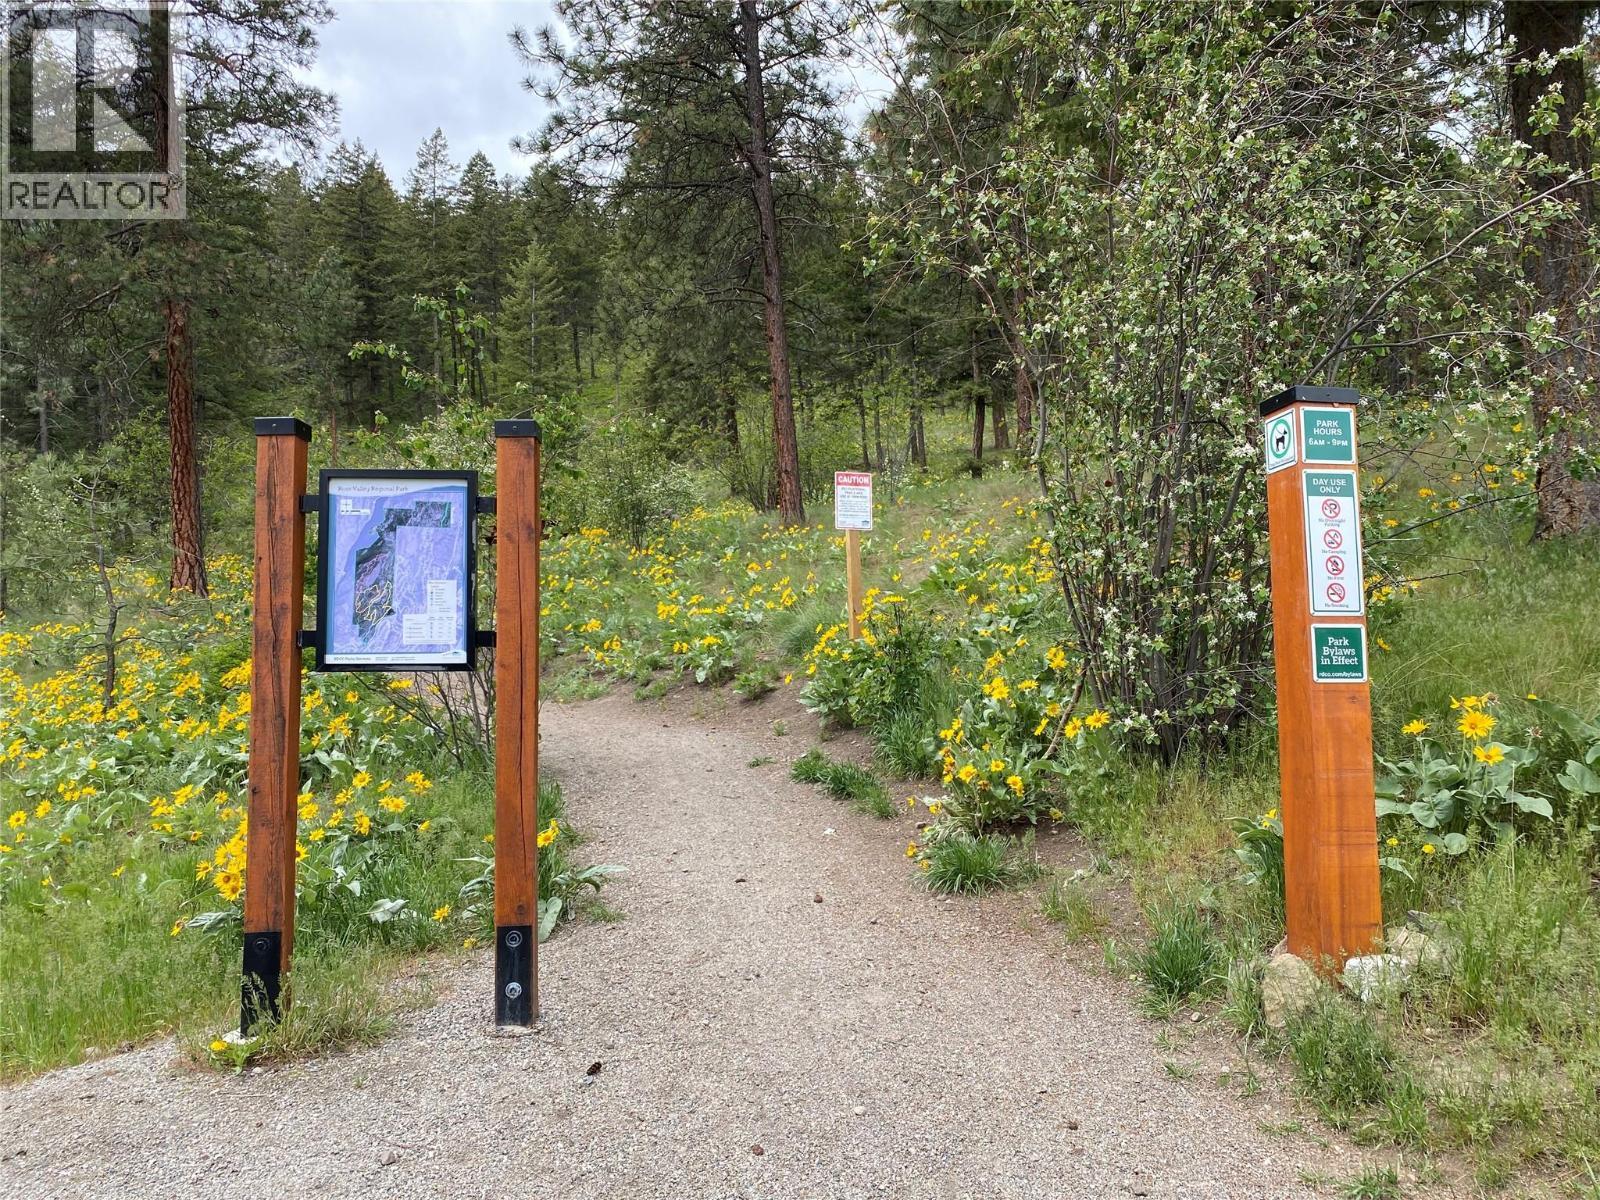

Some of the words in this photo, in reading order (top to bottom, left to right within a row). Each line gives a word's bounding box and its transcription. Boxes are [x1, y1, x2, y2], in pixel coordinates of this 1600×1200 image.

[1316, 420, 1339, 428] PARK
[1313, 428, 1343, 436] HOURS
[1308, 437, 1325, 446] 6AM
[1331, 438, 1348, 447] 9PM
[838, 475, 869, 484] CAUTION
[1313, 478, 1329, 486] DAY
[1330, 478, 1347, 486] USE
[1320, 486, 1341, 494] ONLY
[1328, 637, 1349, 646] Park
[1322, 646, 1356, 657] Bylaws
[1321, 656, 1331, 665] in
[1332, 656, 1358, 665] Effect
